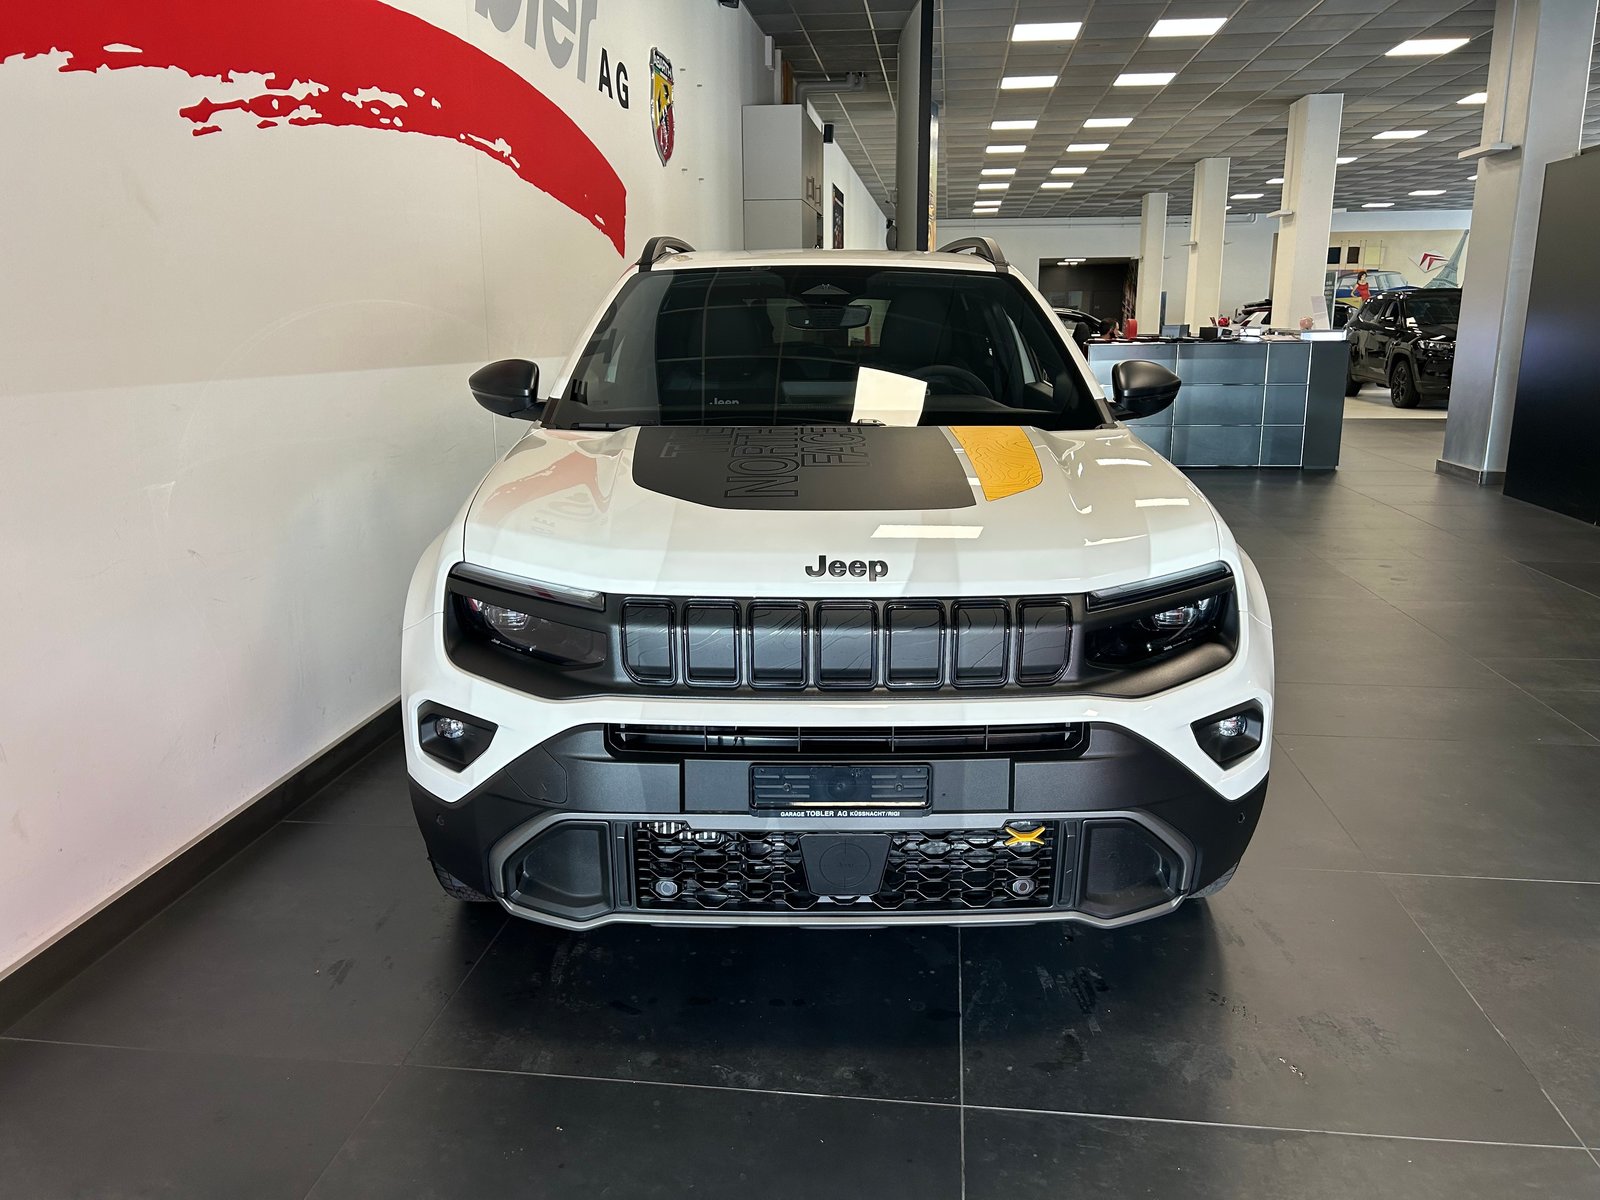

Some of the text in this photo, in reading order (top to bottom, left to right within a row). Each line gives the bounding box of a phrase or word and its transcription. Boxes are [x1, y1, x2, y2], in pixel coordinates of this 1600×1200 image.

[598, 47, 629, 109] AG
[800, 426, 870, 467] FACE
[805, 555, 889, 582] Jeep
